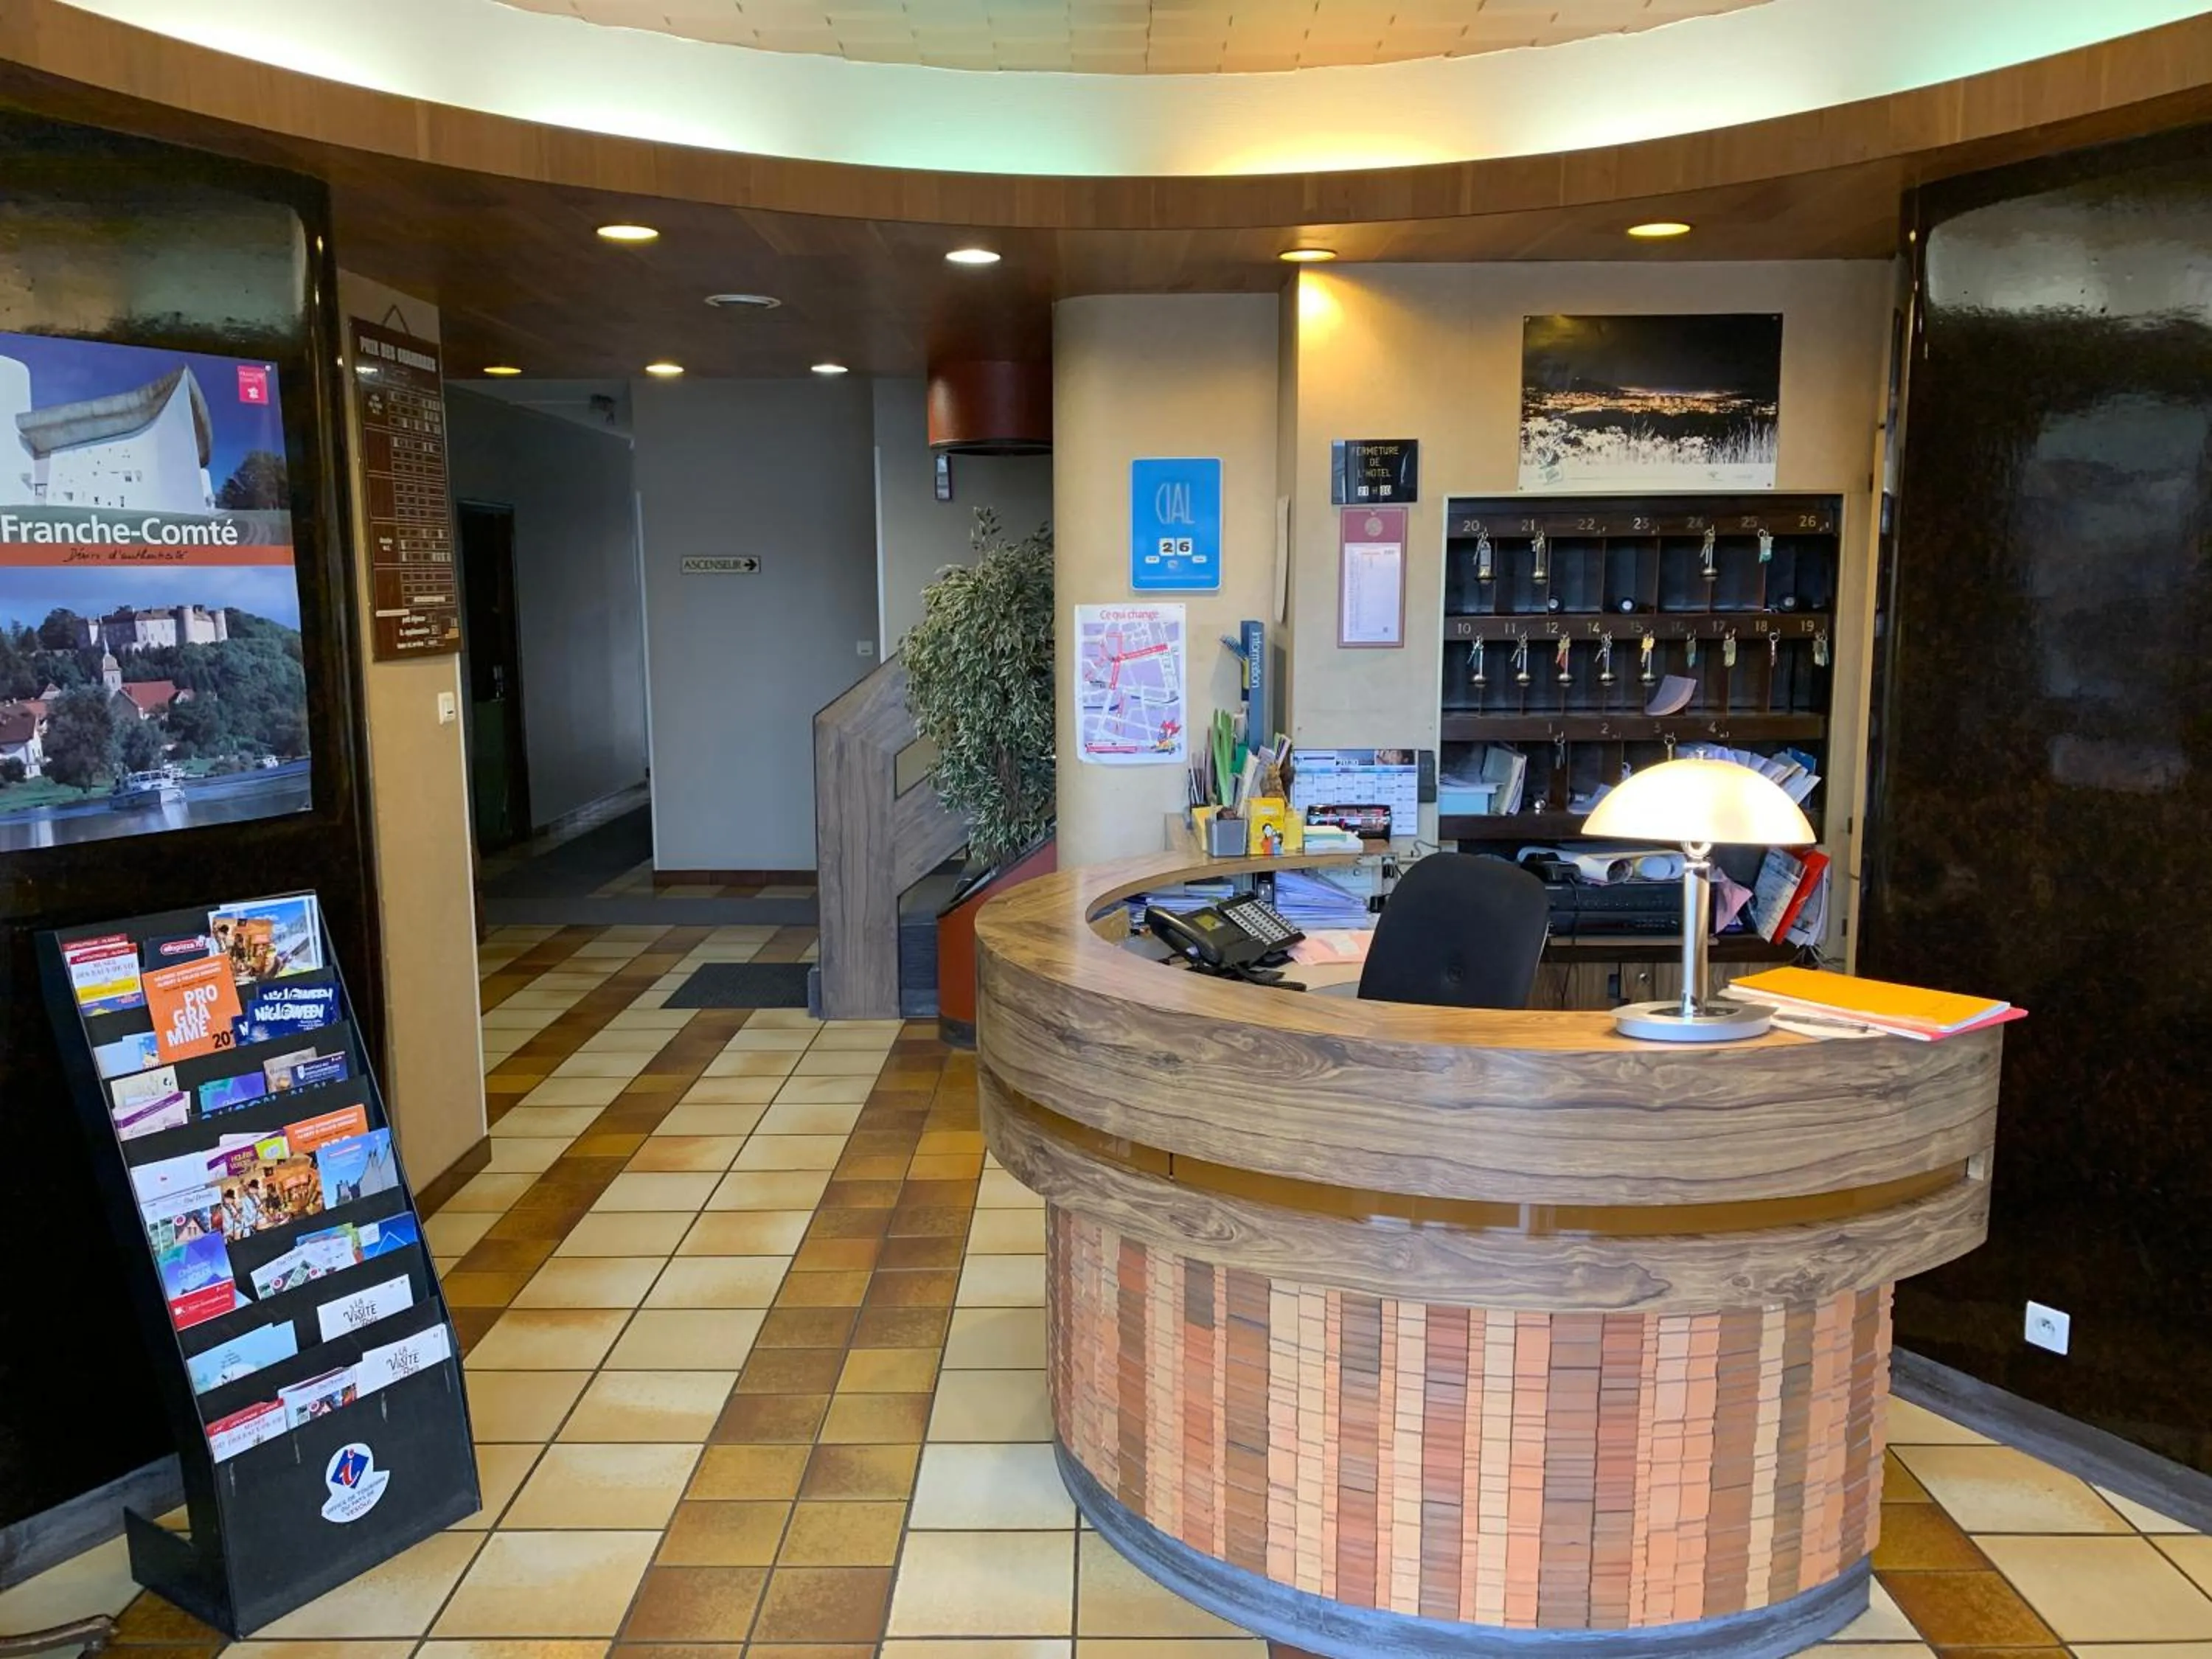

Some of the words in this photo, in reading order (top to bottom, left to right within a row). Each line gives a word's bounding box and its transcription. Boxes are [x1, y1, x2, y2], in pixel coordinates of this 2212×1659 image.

[1369, 457, 1381, 467] DE
[1, 515, 238, 546] Franche-Comté
[1463, 519, 1481, 532] 20
[1521, 518, 1535, 532] 21
[1577, 518, 1595, 531] 22
[1633, 517, 1651, 530] 23
[1741, 516, 1758, 528] 25
[1799, 515, 1817, 528] 26
[1162, 542, 1190, 553] 26
[684, 559, 741, 570] ASCENSEUR
[1099, 610, 1111, 620] Ce
[1127, 610, 1160, 622] change
[1457, 622, 1471, 635] 10
[1504, 622, 1516, 634] 11
[1545, 622, 1558, 634] 12
[1587, 622, 1600, 634] 14
[1712, 620, 1726, 633] 17
[1755, 620, 1767, 633] 18
[1801, 619, 1815, 633] 19
[1601, 722, 1610, 734] 2
[1708, 720, 1717, 734] 4
[184, 984, 218, 1006] PRO
[173, 1004, 212, 1026] GRA
[166, 1020, 209, 1048] MME
[212, 1029, 234, 1049] 20
[354, 1298, 364, 1307] LA
[397, 1346, 408, 1356] LA
